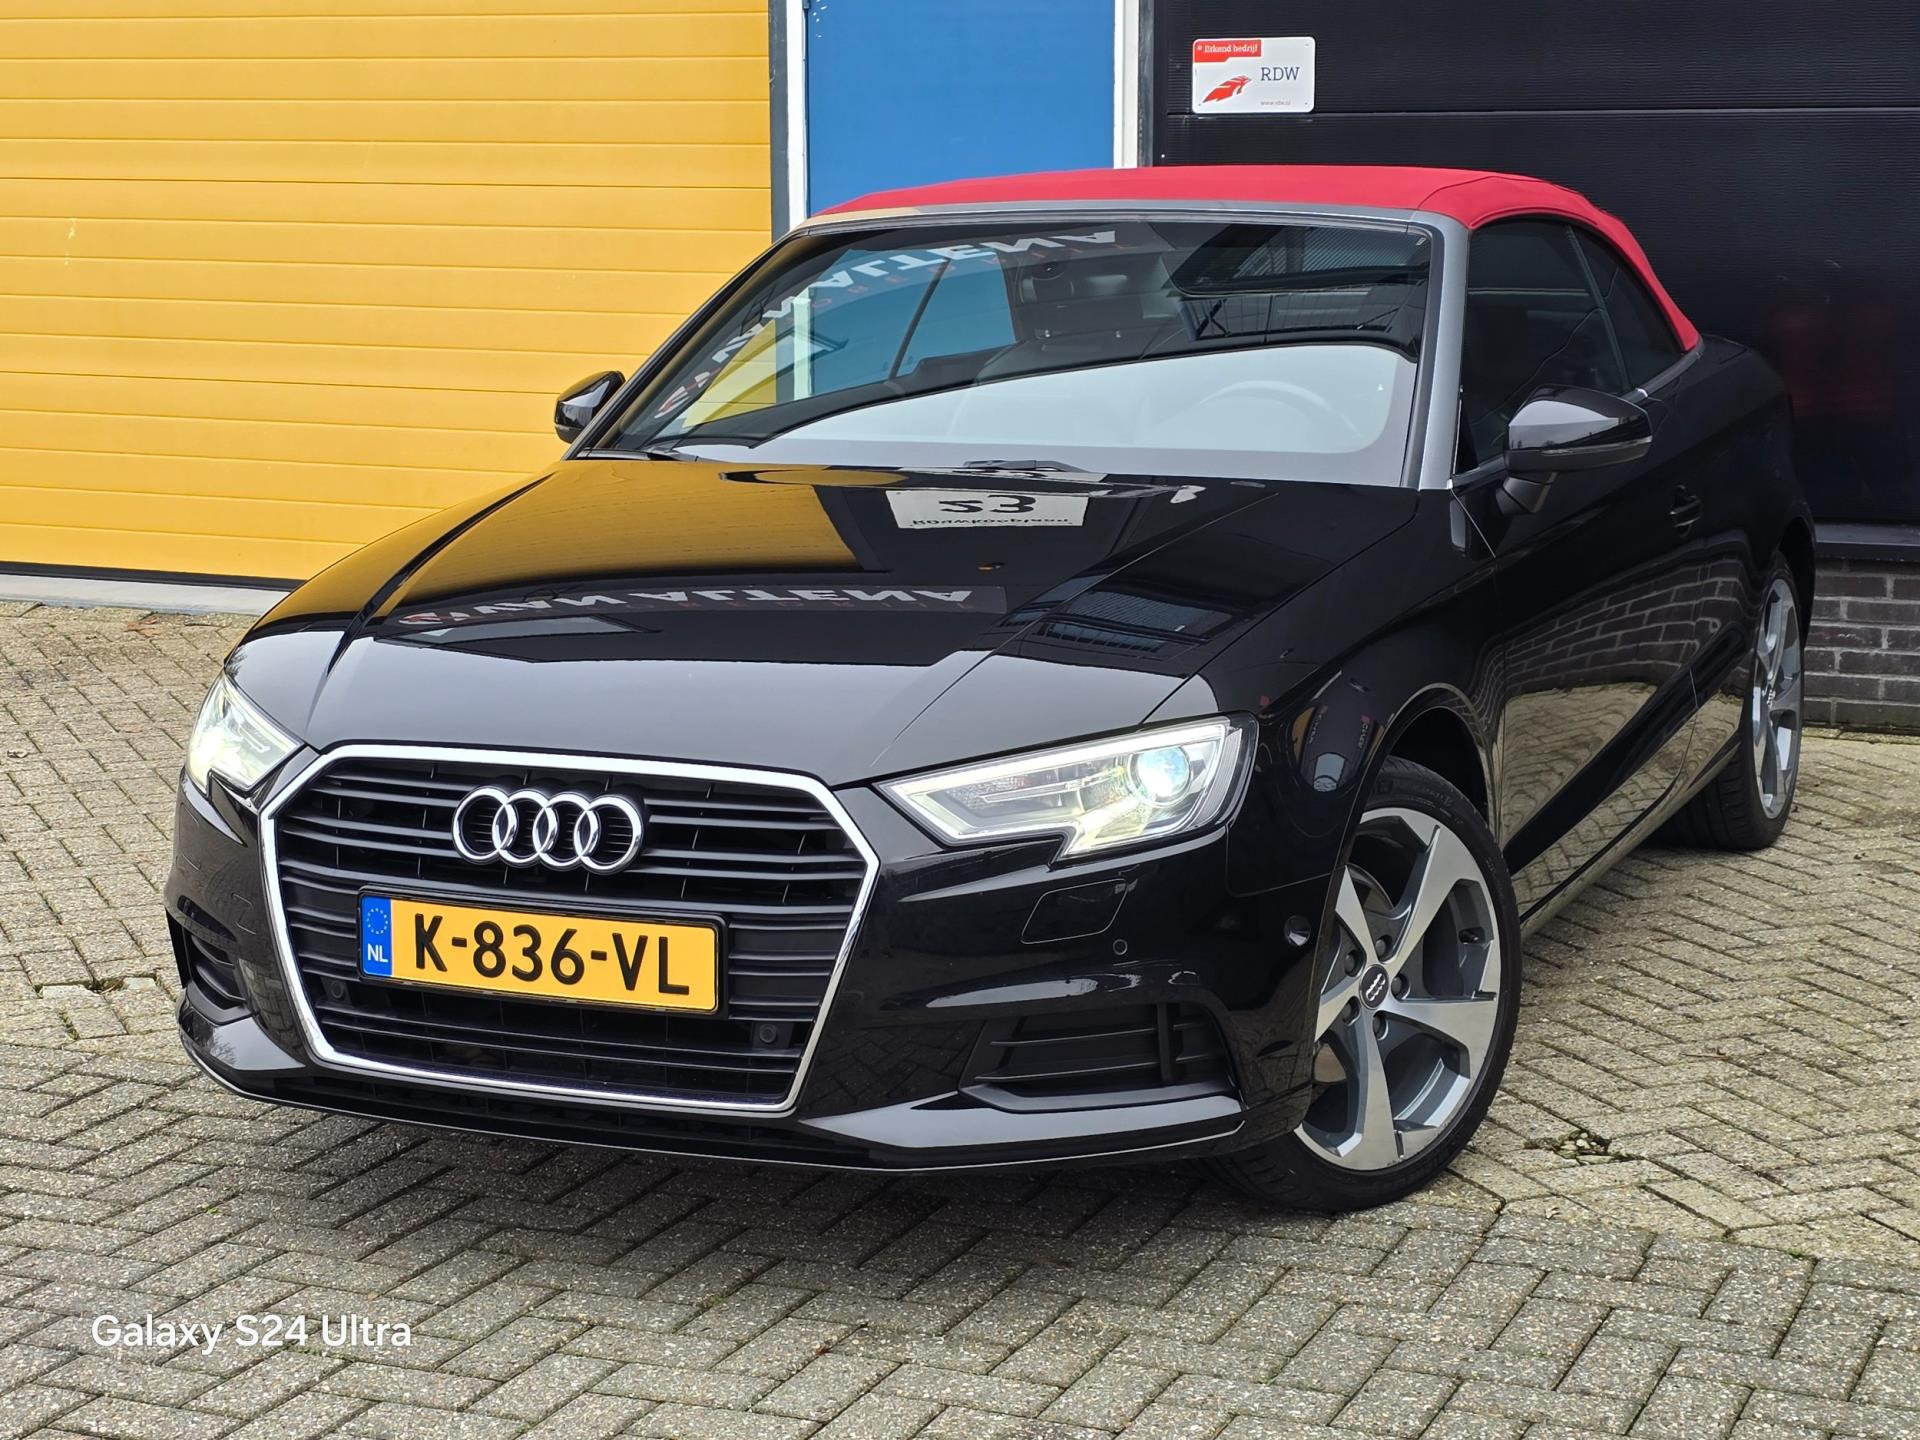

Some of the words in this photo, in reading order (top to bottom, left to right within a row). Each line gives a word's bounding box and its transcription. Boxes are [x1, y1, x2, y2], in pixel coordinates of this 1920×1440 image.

[1260, 66, 1300, 81] RDW
[366, 943, 389, 964] NL
[414, 912, 690, 996] K-836-VL
